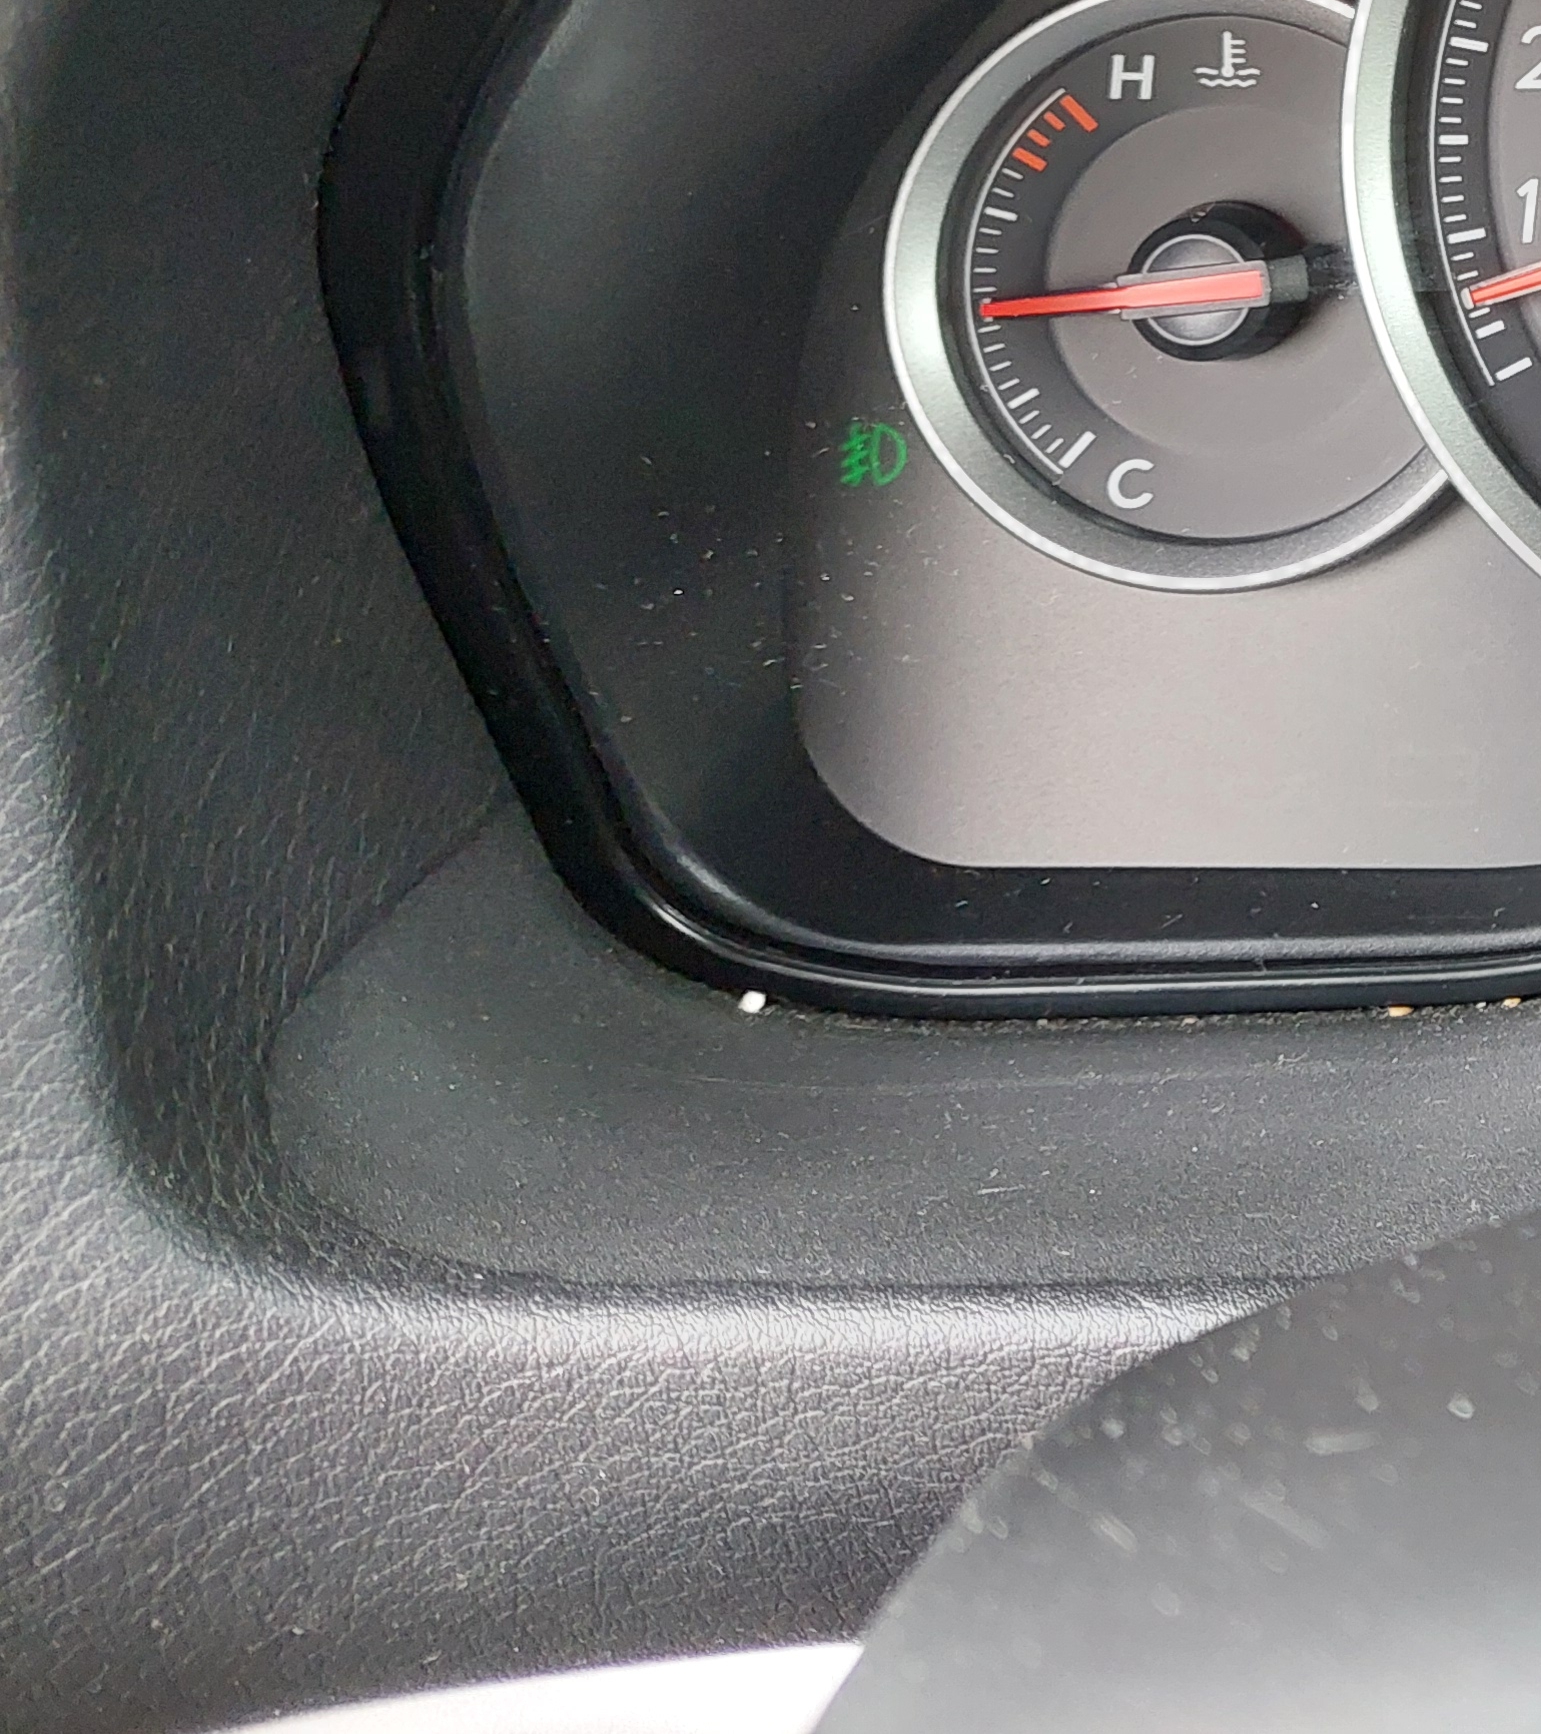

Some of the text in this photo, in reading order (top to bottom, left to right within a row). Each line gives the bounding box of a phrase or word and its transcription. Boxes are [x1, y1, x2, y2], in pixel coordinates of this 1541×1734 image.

[1108, 53, 1156, 101] H
[1515, 177, 1540, 245] 1
[1105, 457, 1156, 511] C
